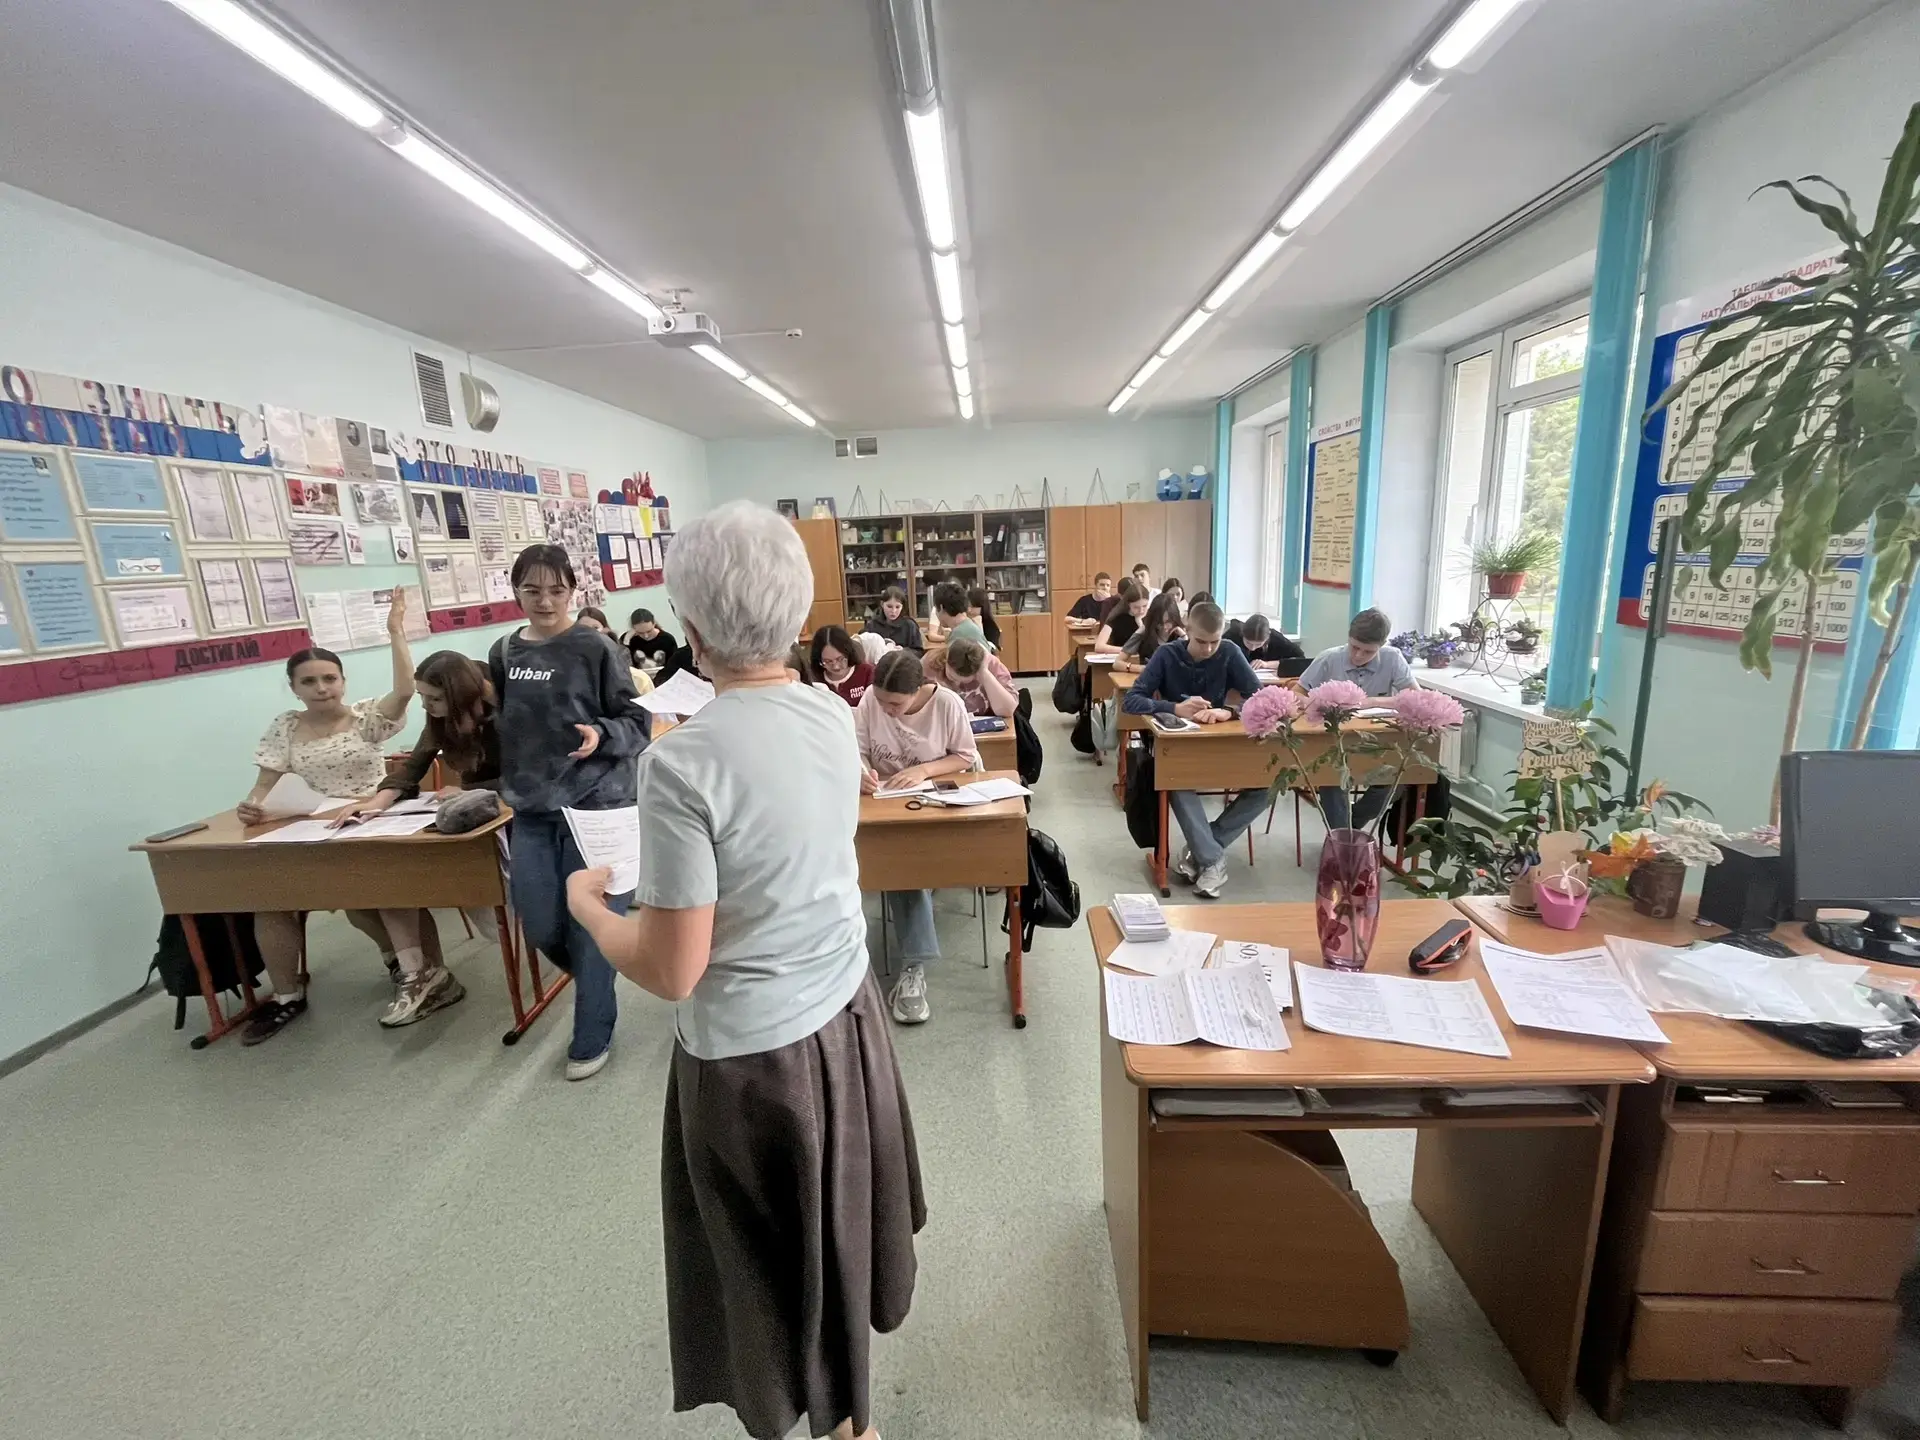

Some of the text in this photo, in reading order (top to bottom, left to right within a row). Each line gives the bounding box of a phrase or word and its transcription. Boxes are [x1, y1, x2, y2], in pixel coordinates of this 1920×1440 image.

[84, 379, 237, 434] ЗНАТЬ
[416, 438, 525, 475] ЭТО ЗНАТЬ
[1752, 518, 1765, 527] 64
[1746, 538, 1764, 547] 729
[1725, 574, 1732, 583] 5
[1745, 576, 1752, 584] 6
[1790, 577, 1798, 586] 8
[1840, 580, 1852, 589] 10
[1689, 591, 1696, 599] 9
[1703, 592, 1713, 600] 16
[1719, 593, 1730, 602] 25
[1739, 595, 1751, 603] 36
[1830, 602, 1847, 611] 100
[1684, 609, 1695, 617] 27
[1699, 611, 1709, 619] 64
[1715, 611, 1729, 621] 125
[1731, 613, 1749, 623] 216
[1776, 617, 1795, 627] 512
[1826, 622, 1848, 633] 1000
[174, 638, 261, 673] ДОСТИГАЙ
[508, 666, 552, 681] Urban
